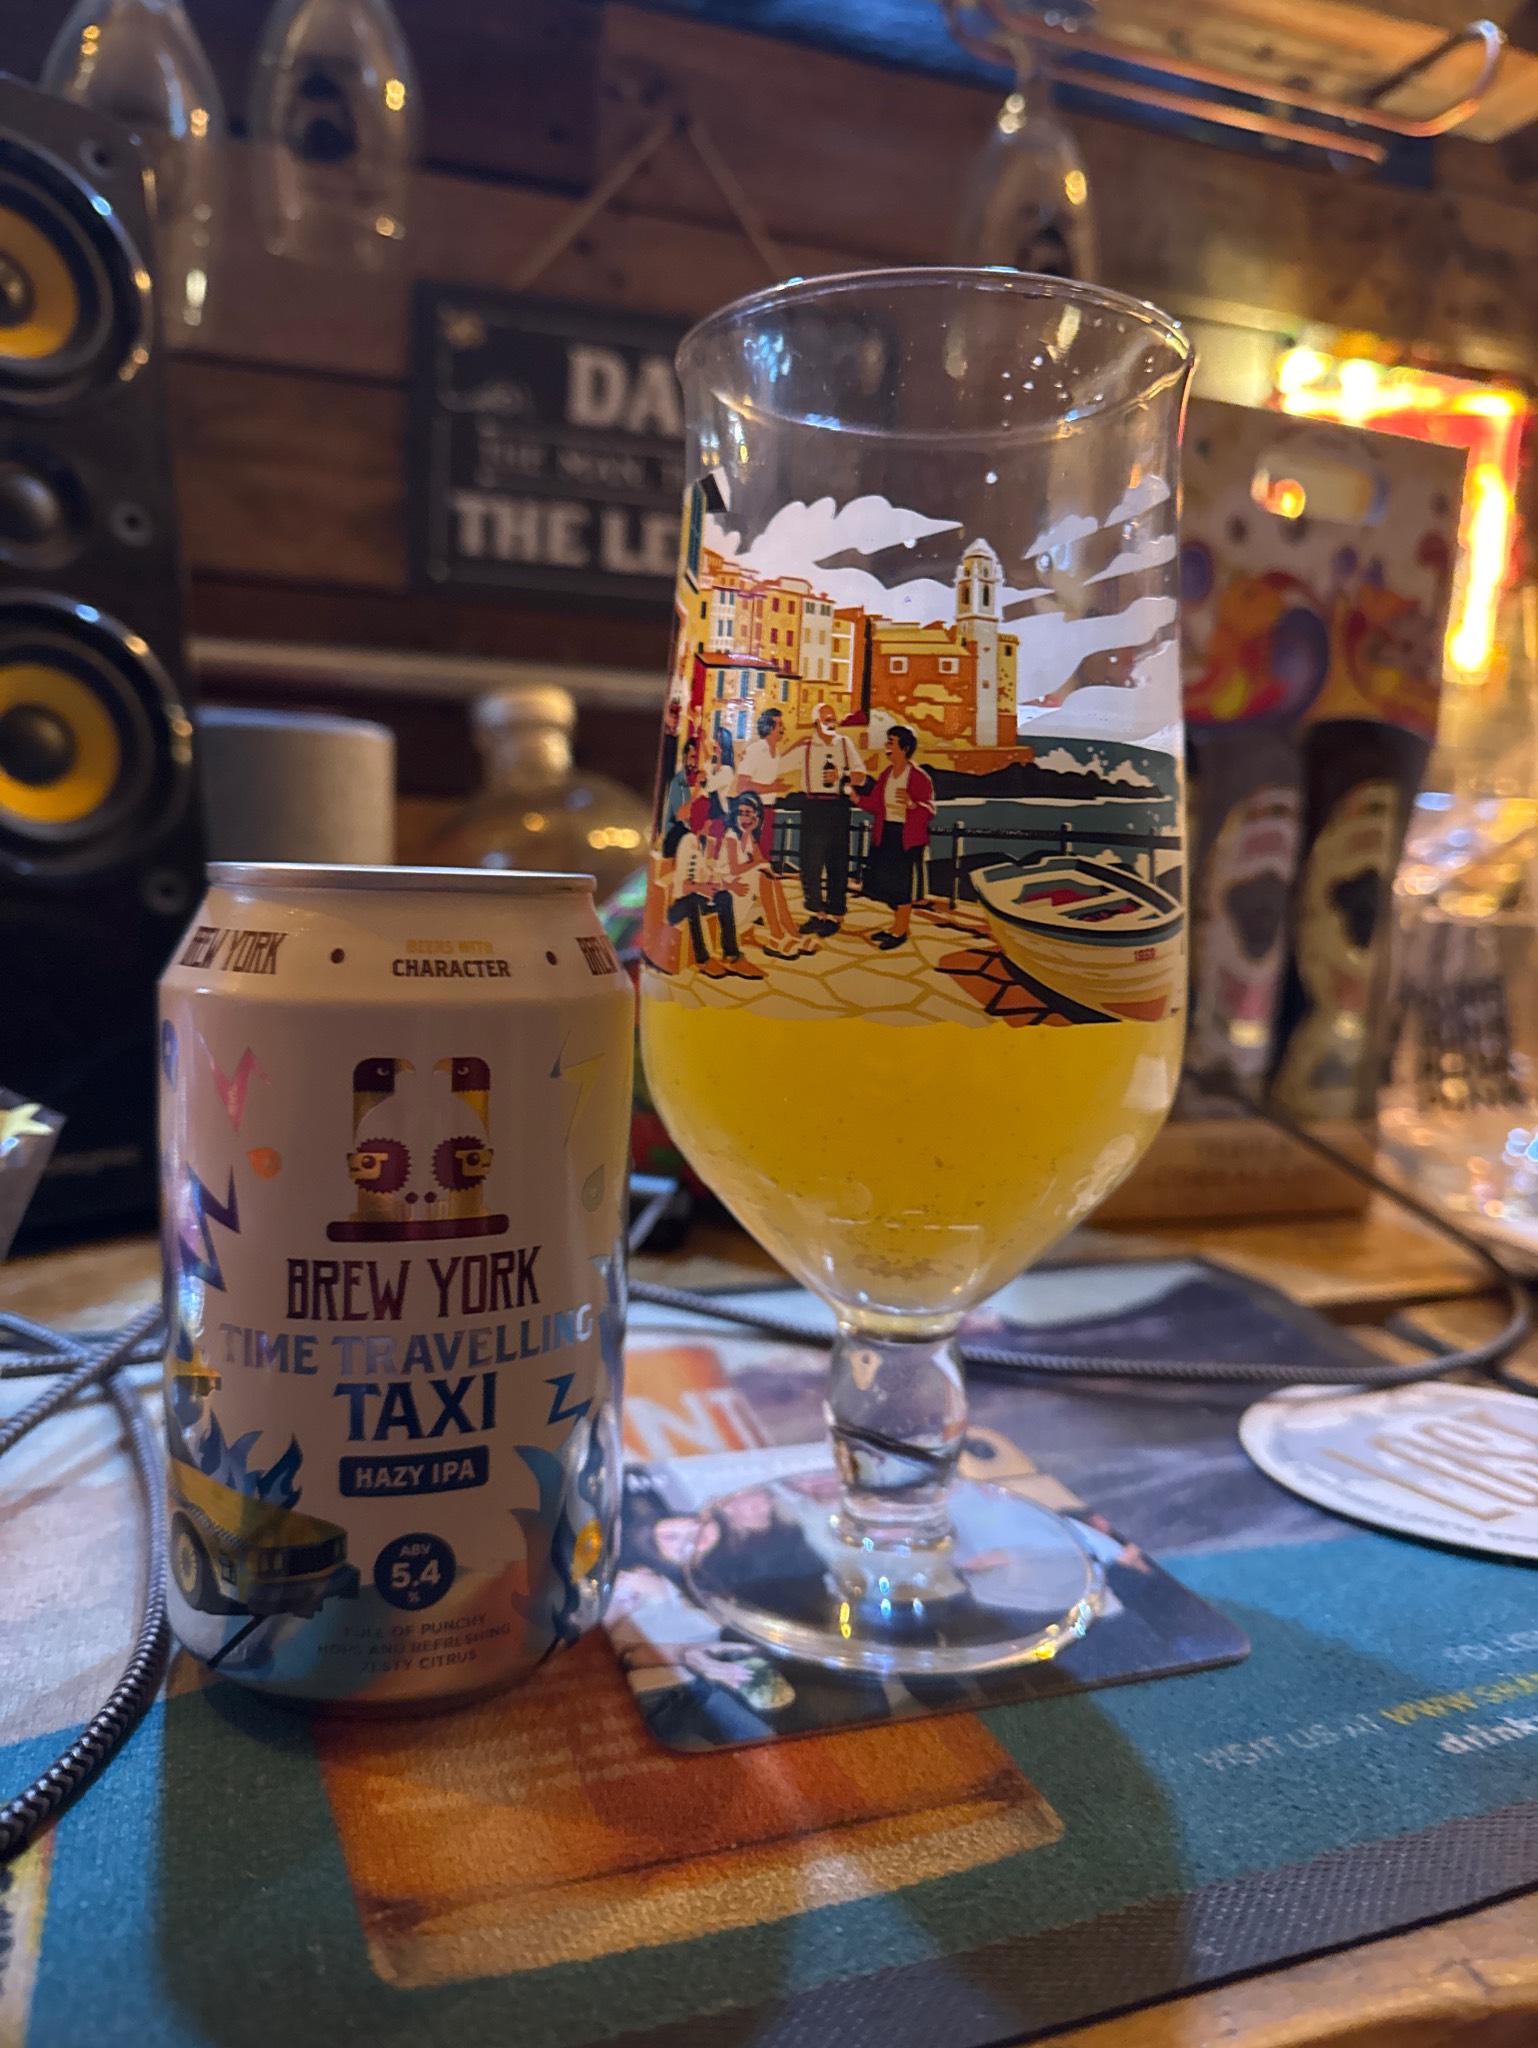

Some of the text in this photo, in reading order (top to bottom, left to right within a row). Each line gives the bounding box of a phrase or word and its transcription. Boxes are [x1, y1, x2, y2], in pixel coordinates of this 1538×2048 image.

[567, 345, 686, 438] DA
[450, 489, 682, 576] THE LE
[220, 928, 288, 975] YORK
[392, 959, 511, 978] CHARACTER
[286, 1244, 542, 1321] BREW YORK
[218, 1302, 594, 1376] TIME TRAVELLING
[333, 1371, 498, 1442] TAXI
[354, 1458, 475, 1490] HAZY IPA
[400, 1542, 432, 1556] ABV
[391, 1559, 441, 1589] 5.4
[368, 1642, 406, 1656] AND
[411, 1622, 511, 1654] REFRESHING
[391, 1624, 415, 1637] OF
[421, 1612, 488, 1636] PUNCHY
[419, 1649, 478, 1670] CITRUS
[1194, 1735, 1285, 1771] VISIT
[1286, 1723, 1341, 1750] US
